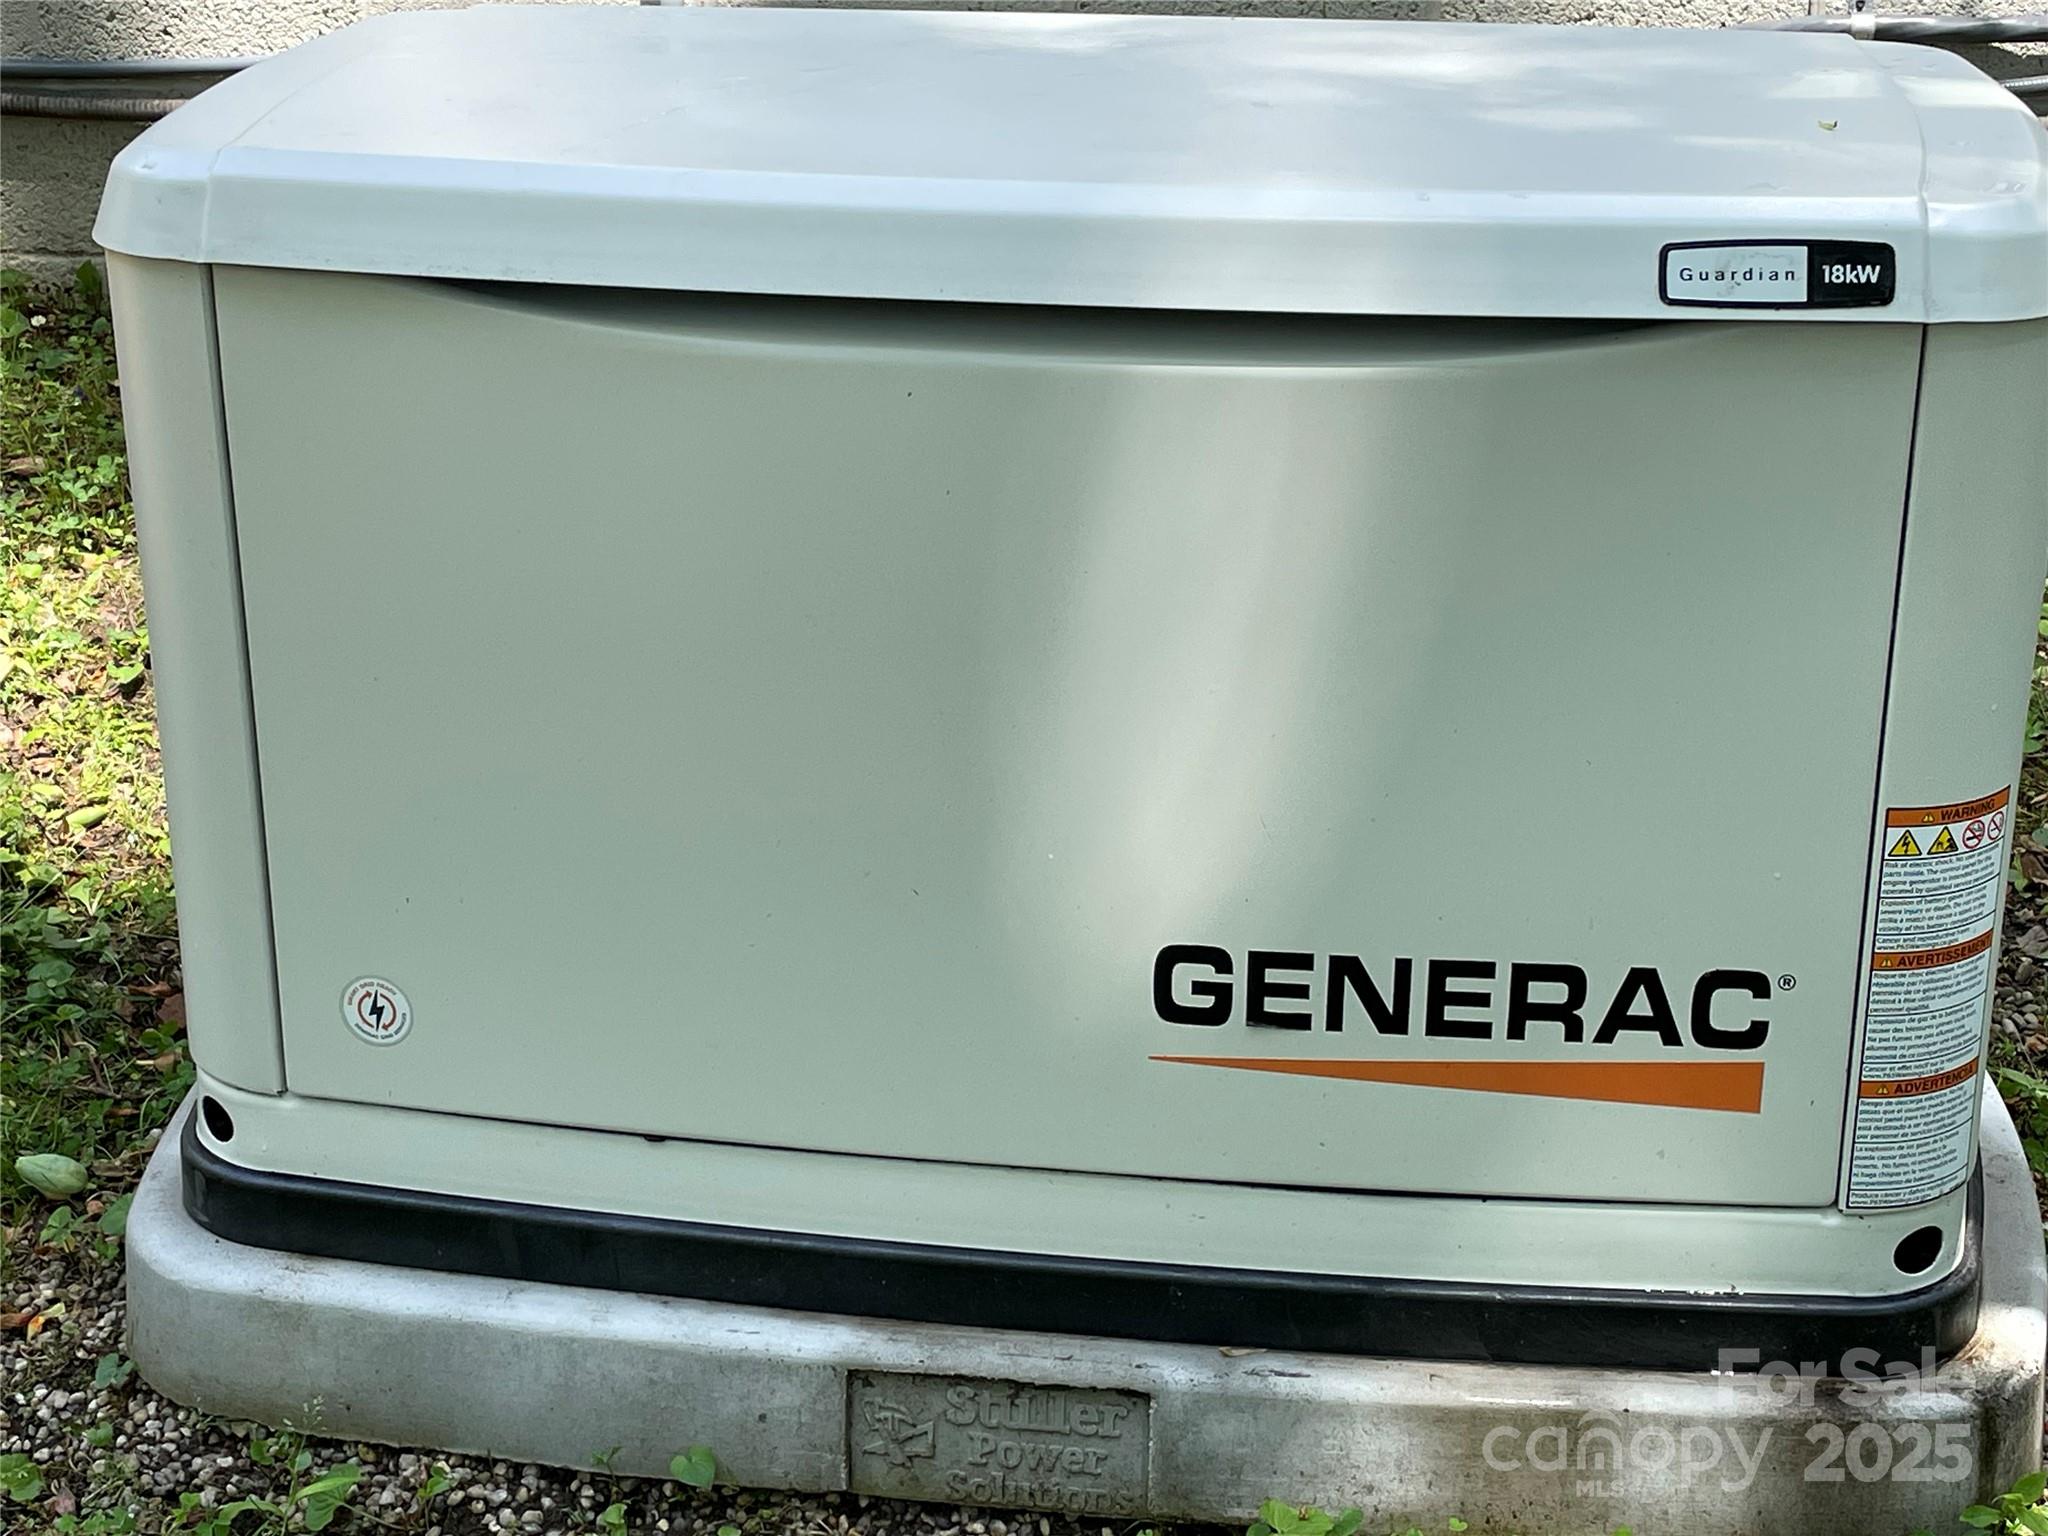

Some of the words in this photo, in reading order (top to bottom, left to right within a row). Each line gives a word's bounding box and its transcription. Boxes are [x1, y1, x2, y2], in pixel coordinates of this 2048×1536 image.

[1679, 267, 1795, 281] Guardian
[1822, 264, 1881, 284] 18kW
[1941, 799, 1995, 820] WARNING
[1897, 937, 1991, 967] AVERTISSEMENT
[1894, 1065, 1973, 1094] ADVERTENCIA
[968, 1432, 1108, 1475] Power
